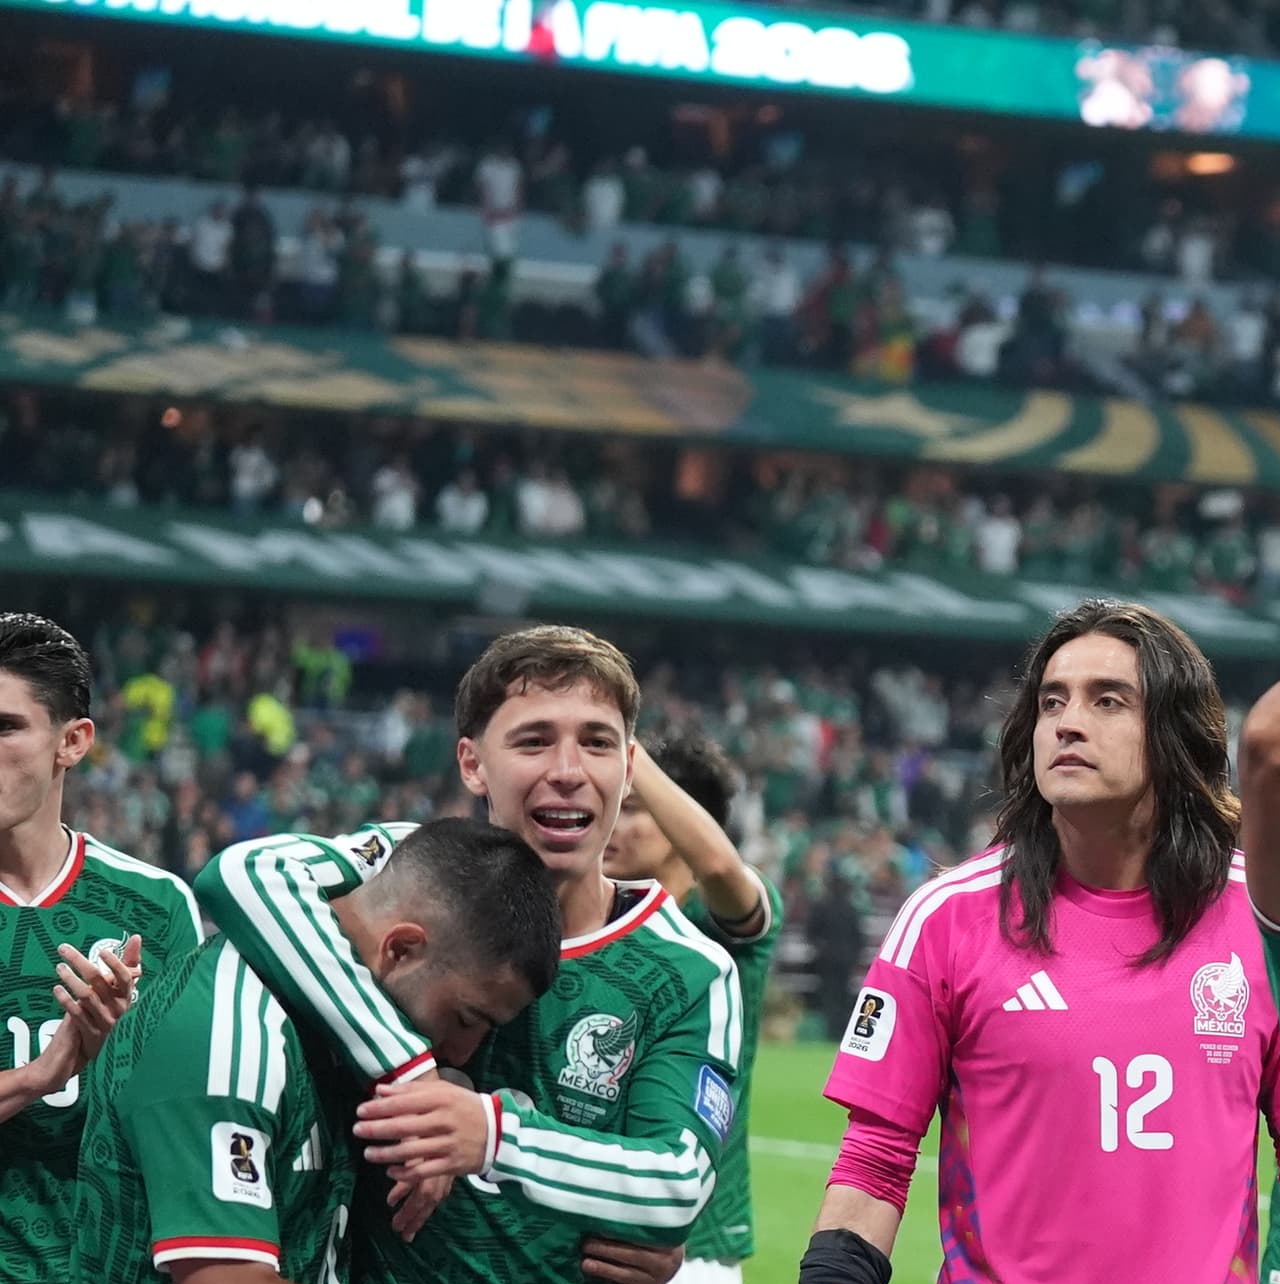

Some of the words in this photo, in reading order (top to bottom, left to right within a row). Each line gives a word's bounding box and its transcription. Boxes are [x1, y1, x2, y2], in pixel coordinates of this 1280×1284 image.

[1197, 1018, 1243, 1034] MÉXICO
[560, 1071, 617, 1098] MÉXICO
[1092, 1054, 1174, 1152] 12
